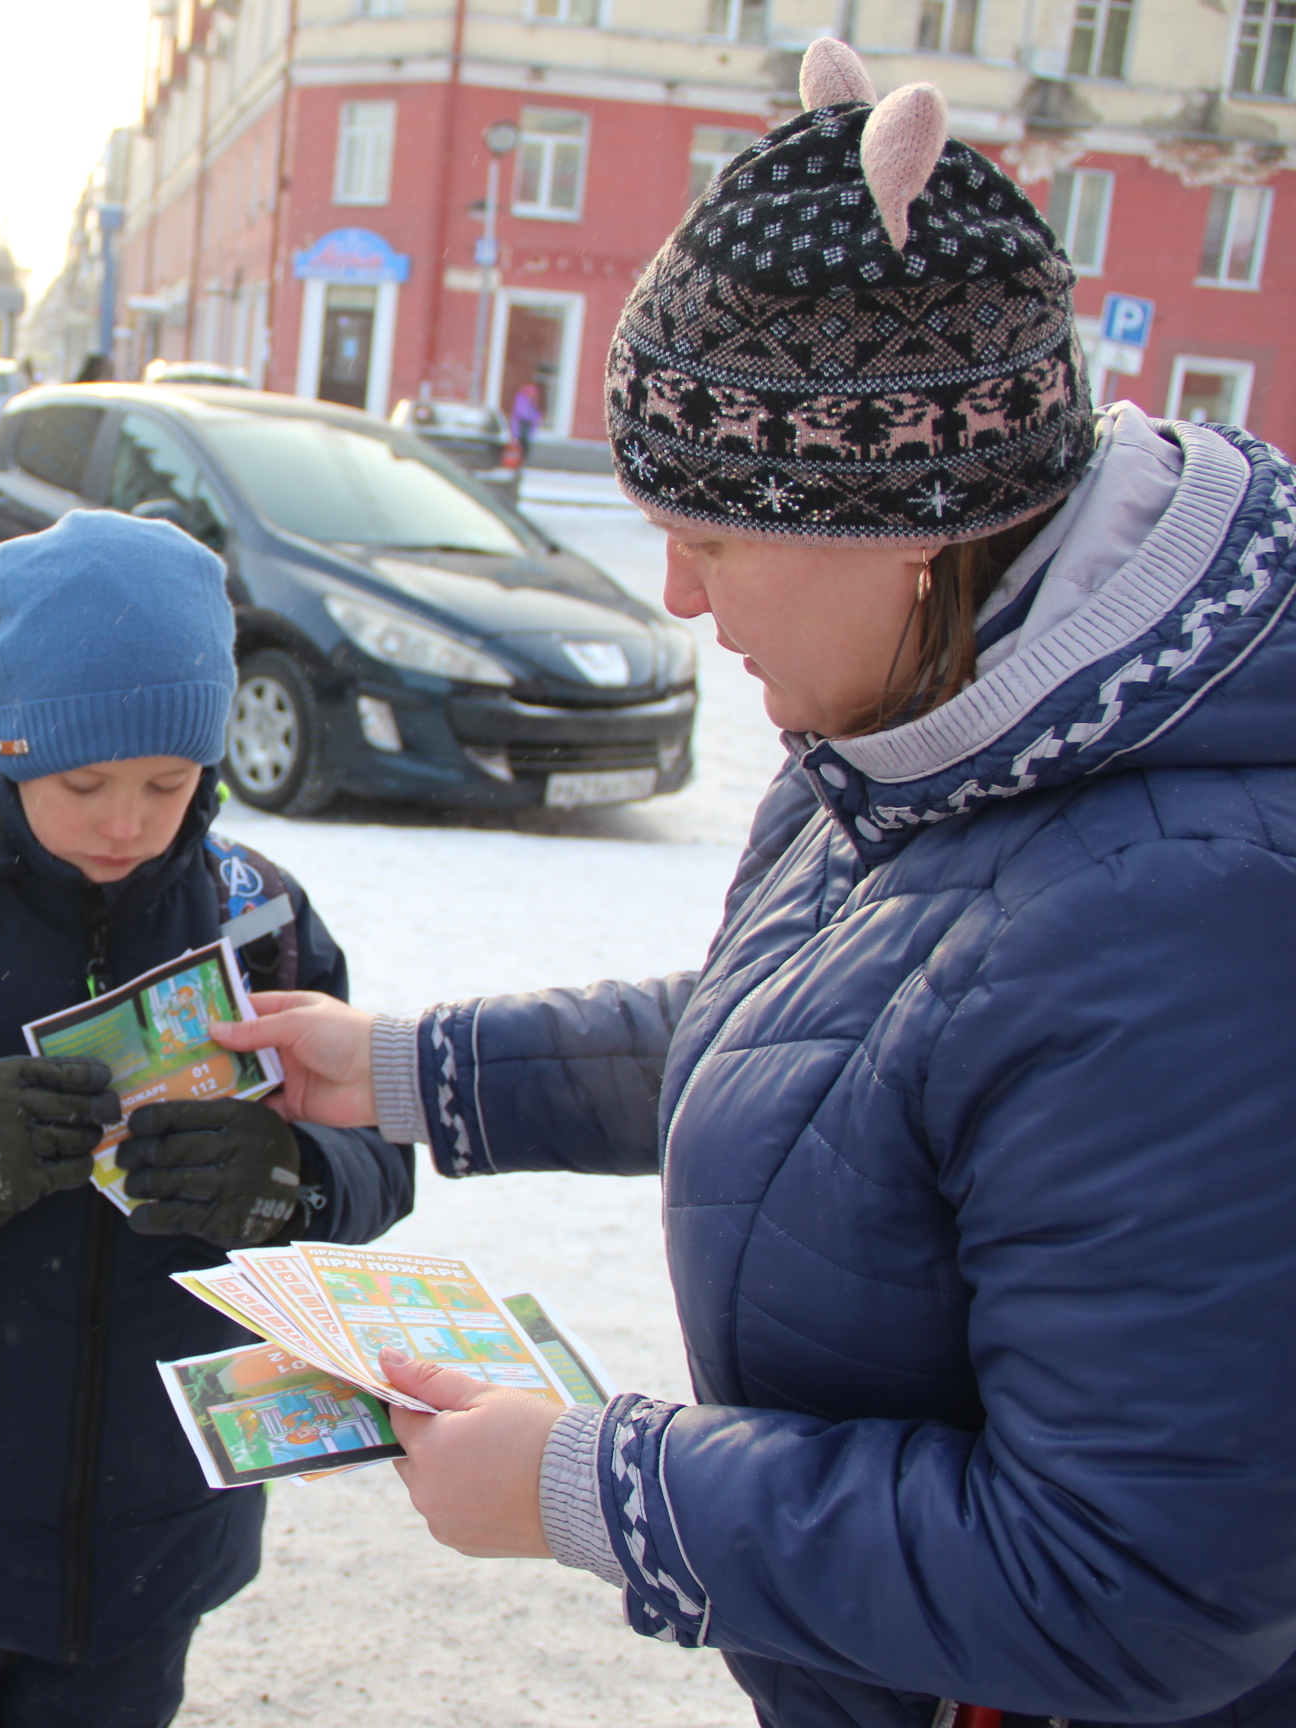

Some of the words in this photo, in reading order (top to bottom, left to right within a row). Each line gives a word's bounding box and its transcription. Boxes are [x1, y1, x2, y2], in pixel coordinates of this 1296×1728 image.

[1111, 299, 1145, 340] P
[191, 1063, 210, 1078] 01
[190, 1078, 218, 1096] 112
[309, 1249, 376, 1260] ПРАВИЛА
[377, 1255, 461, 1268] ПОВЕДЕНИЯ
[312, 1257, 363, 1269] ПРИ
[366, 1262, 468, 1279] ПОЖАРЕ
